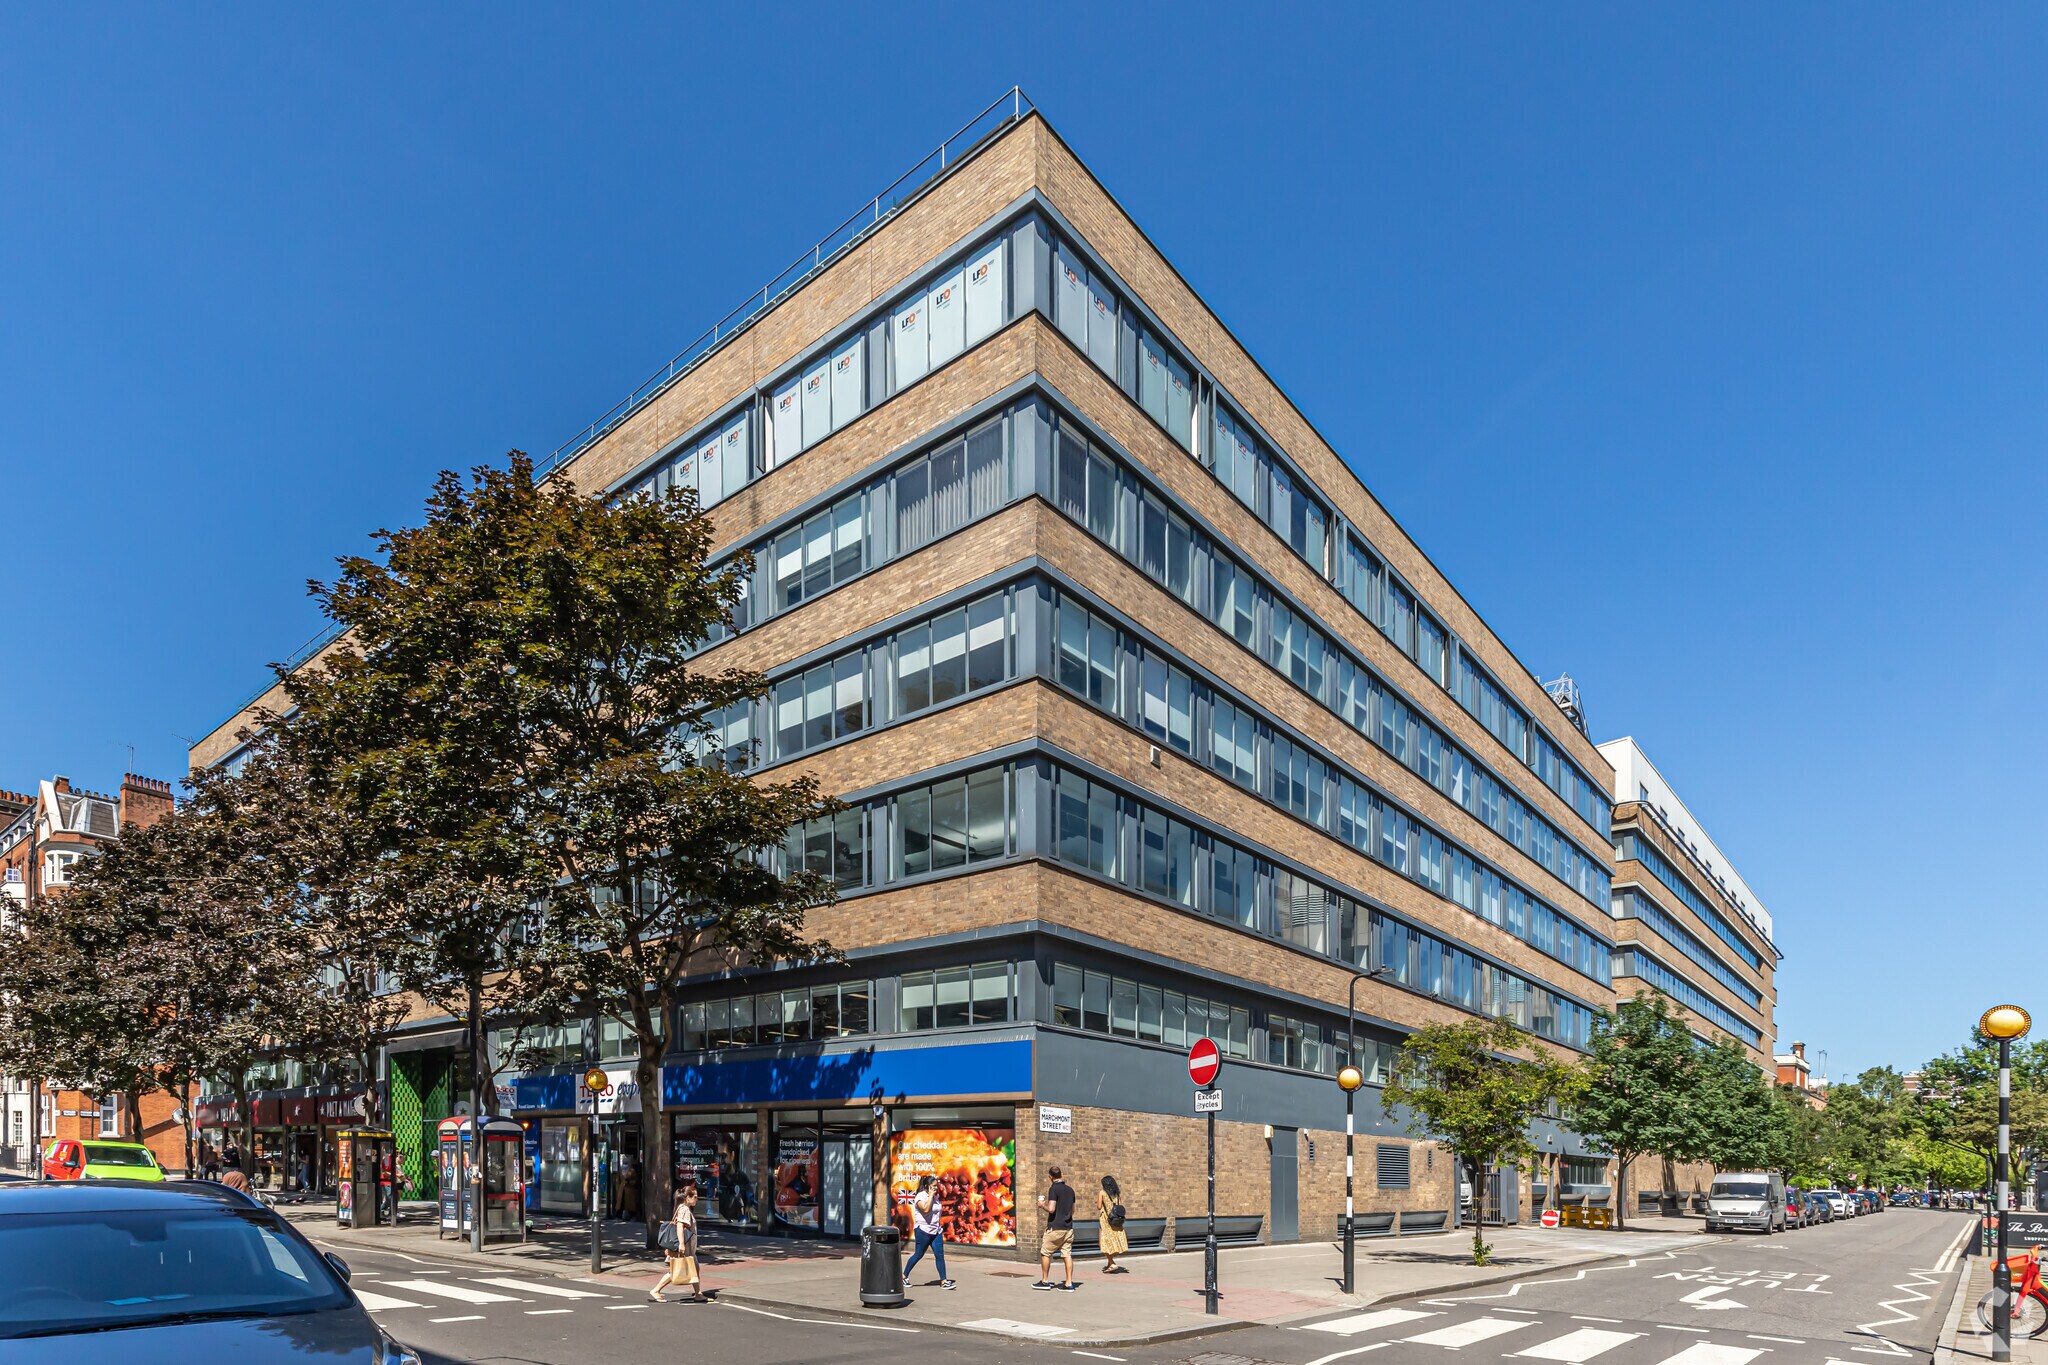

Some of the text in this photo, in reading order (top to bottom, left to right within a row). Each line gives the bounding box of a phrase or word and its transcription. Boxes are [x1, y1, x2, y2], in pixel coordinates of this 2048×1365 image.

[972, 264, 988, 281] LFO
[936, 288, 951, 305] LFO
[901, 312, 916, 329] LFO
[837, 356, 850, 371] LFO
[807, 376, 820, 390] LFO
[780, 395, 792, 409] LFO
[580, 1081, 641, 1100] TECO expr
[1041, 1113, 1071, 1123] MARCHMONT
[1042, 1122, 1062, 1130] STREET
[679, 1140, 696, 1149] Serving
[779, 1139, 814, 1147] Fresh berries
[897, 1140, 948, 1149] Our cheddars
[779, 1148, 810, 1157] handpicked
[911, 1151, 932, 1160] made
[897, 1162, 935, 1171] with 100%
[897, 1172, 921, 1182] British
[2007, 1221, 2026, 1232] The
[1682, 1266, 1831, 1282] LEFT
[1652, 1272, 1833, 1294] TURN
